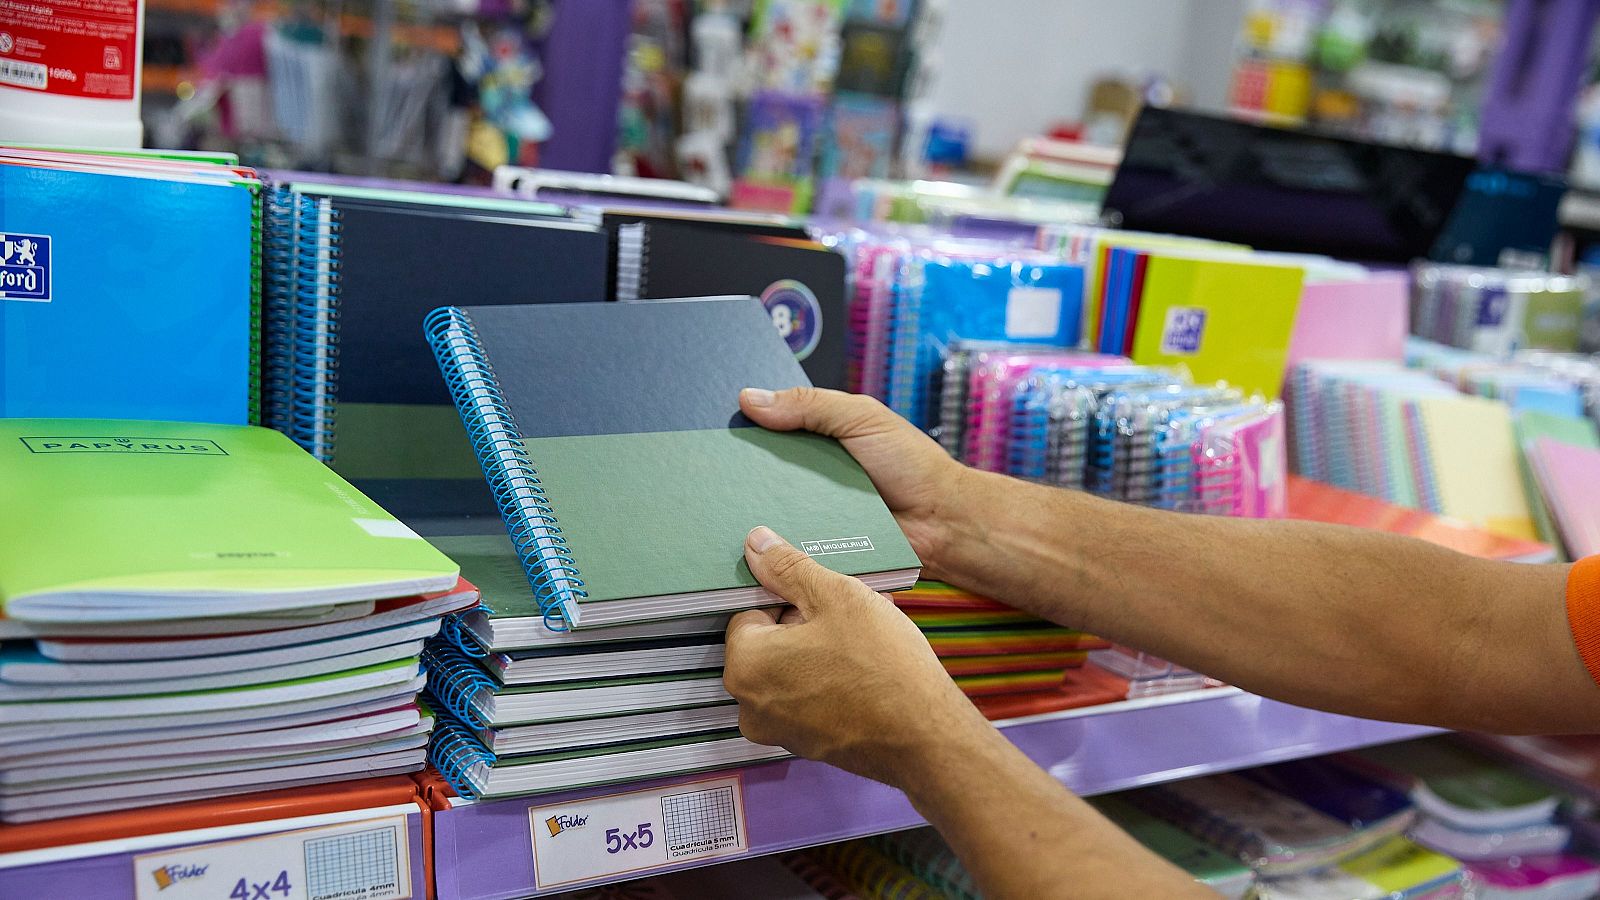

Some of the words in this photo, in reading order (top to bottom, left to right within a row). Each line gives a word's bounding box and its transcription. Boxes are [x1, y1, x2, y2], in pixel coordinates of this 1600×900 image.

[42, 440, 209, 452] PAPYRUS
[822, 540, 869, 550] MIQUELRIUS
[555, 813, 589, 829] Folder
[605, 822, 654, 854] 5x5
[229, 870, 292, 900] 4x4
